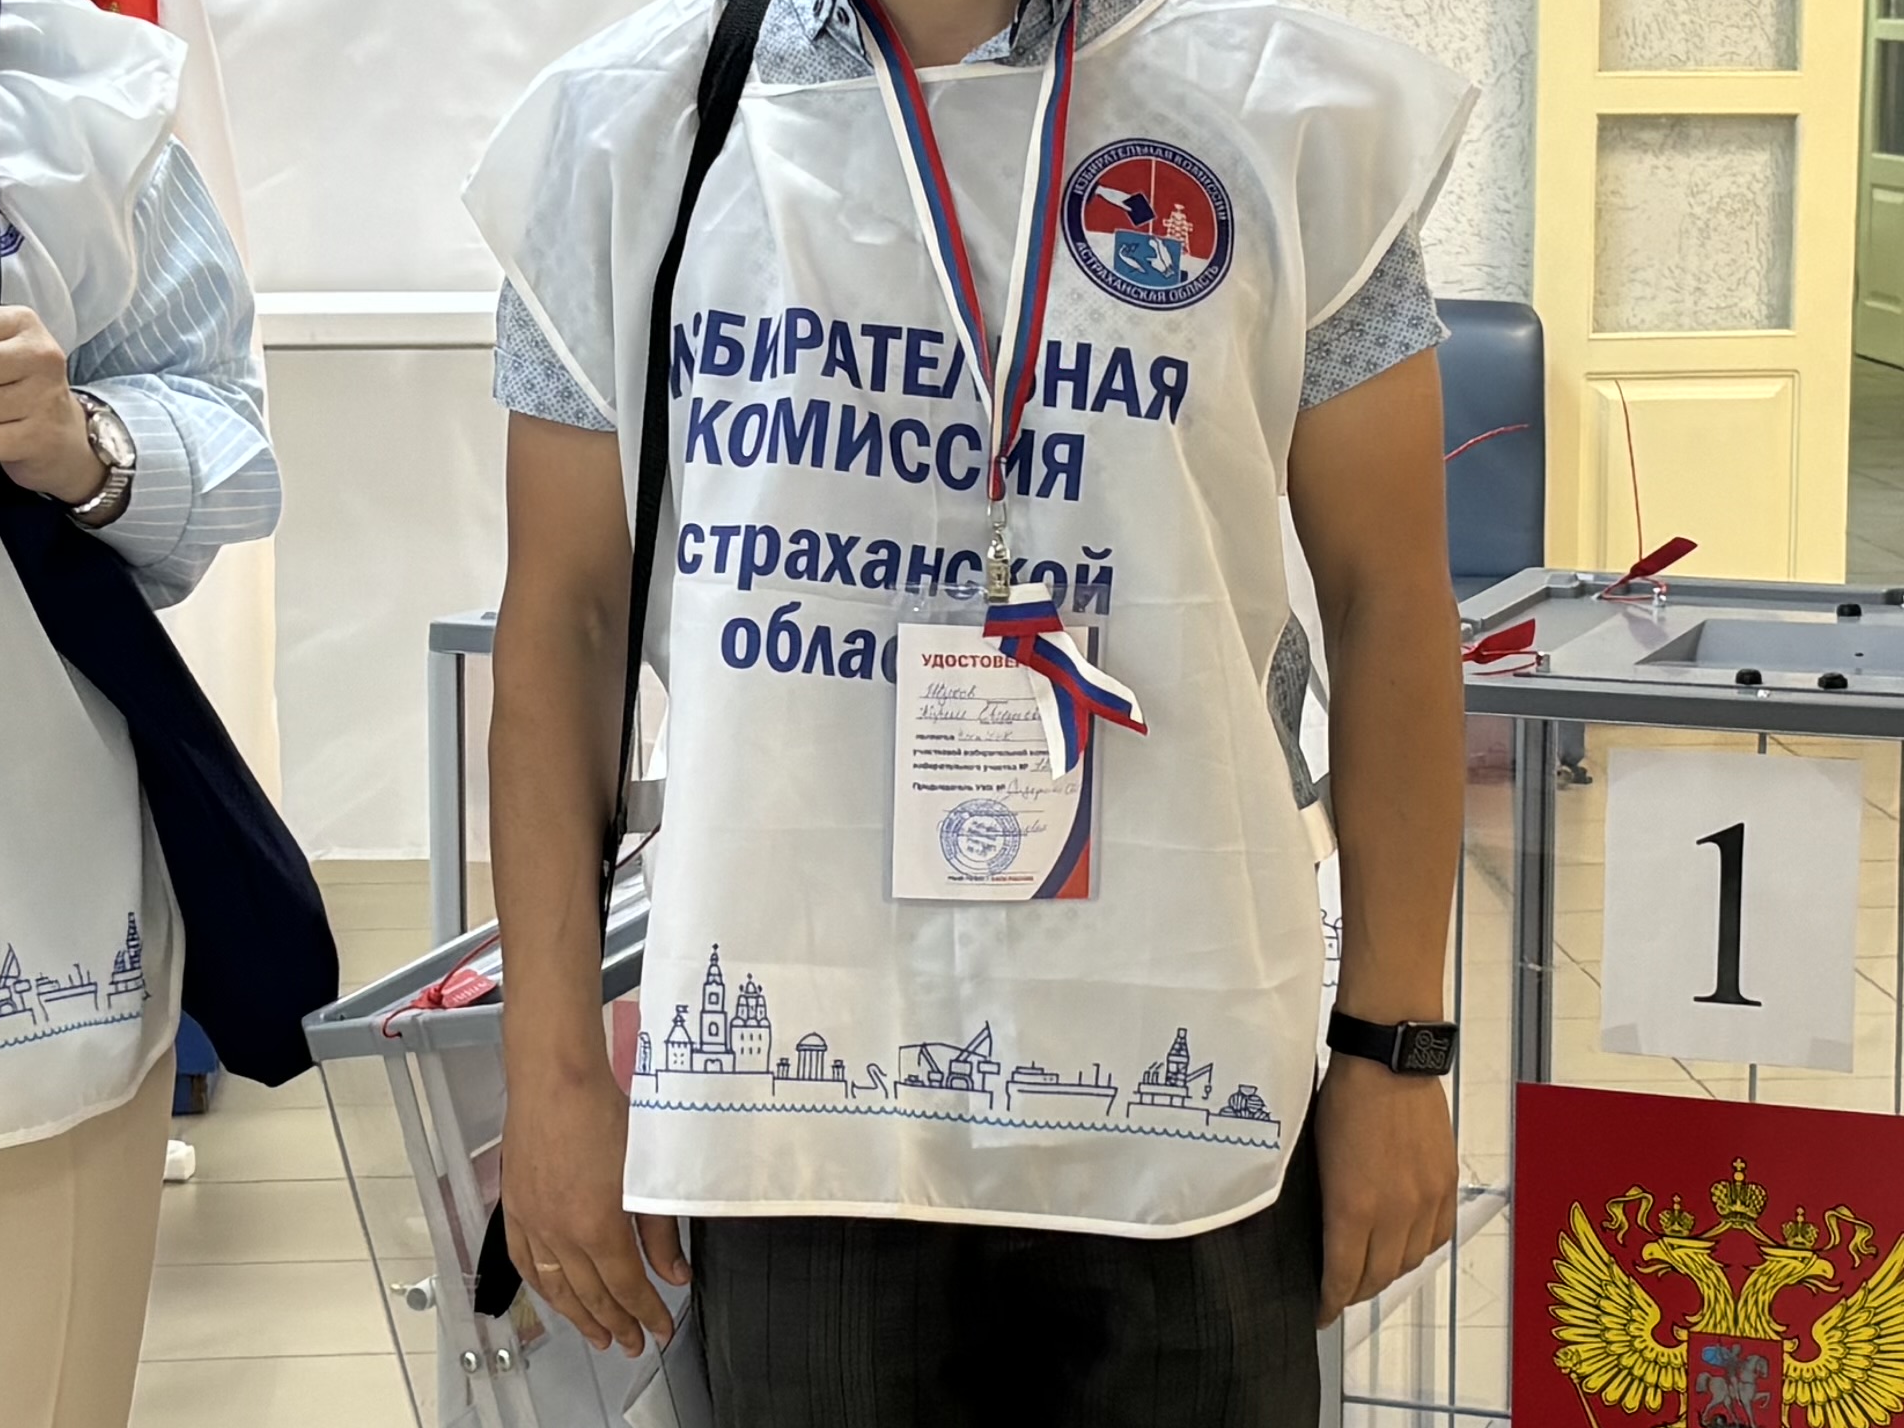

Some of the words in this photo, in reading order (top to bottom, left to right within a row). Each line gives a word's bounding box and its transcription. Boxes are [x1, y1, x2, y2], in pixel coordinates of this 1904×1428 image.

[1075, 241, 1166, 303] АСТРАХАНСКАЯ
[1169, 264, 1219, 303] ОБЛАСТЬ
[677, 523, 1114, 616] страхансой
[721, 601, 898, 684] обла
[921, 653, 1022, 669] УДОСТОВЕ
[1694, 821, 1762, 1008] 1
